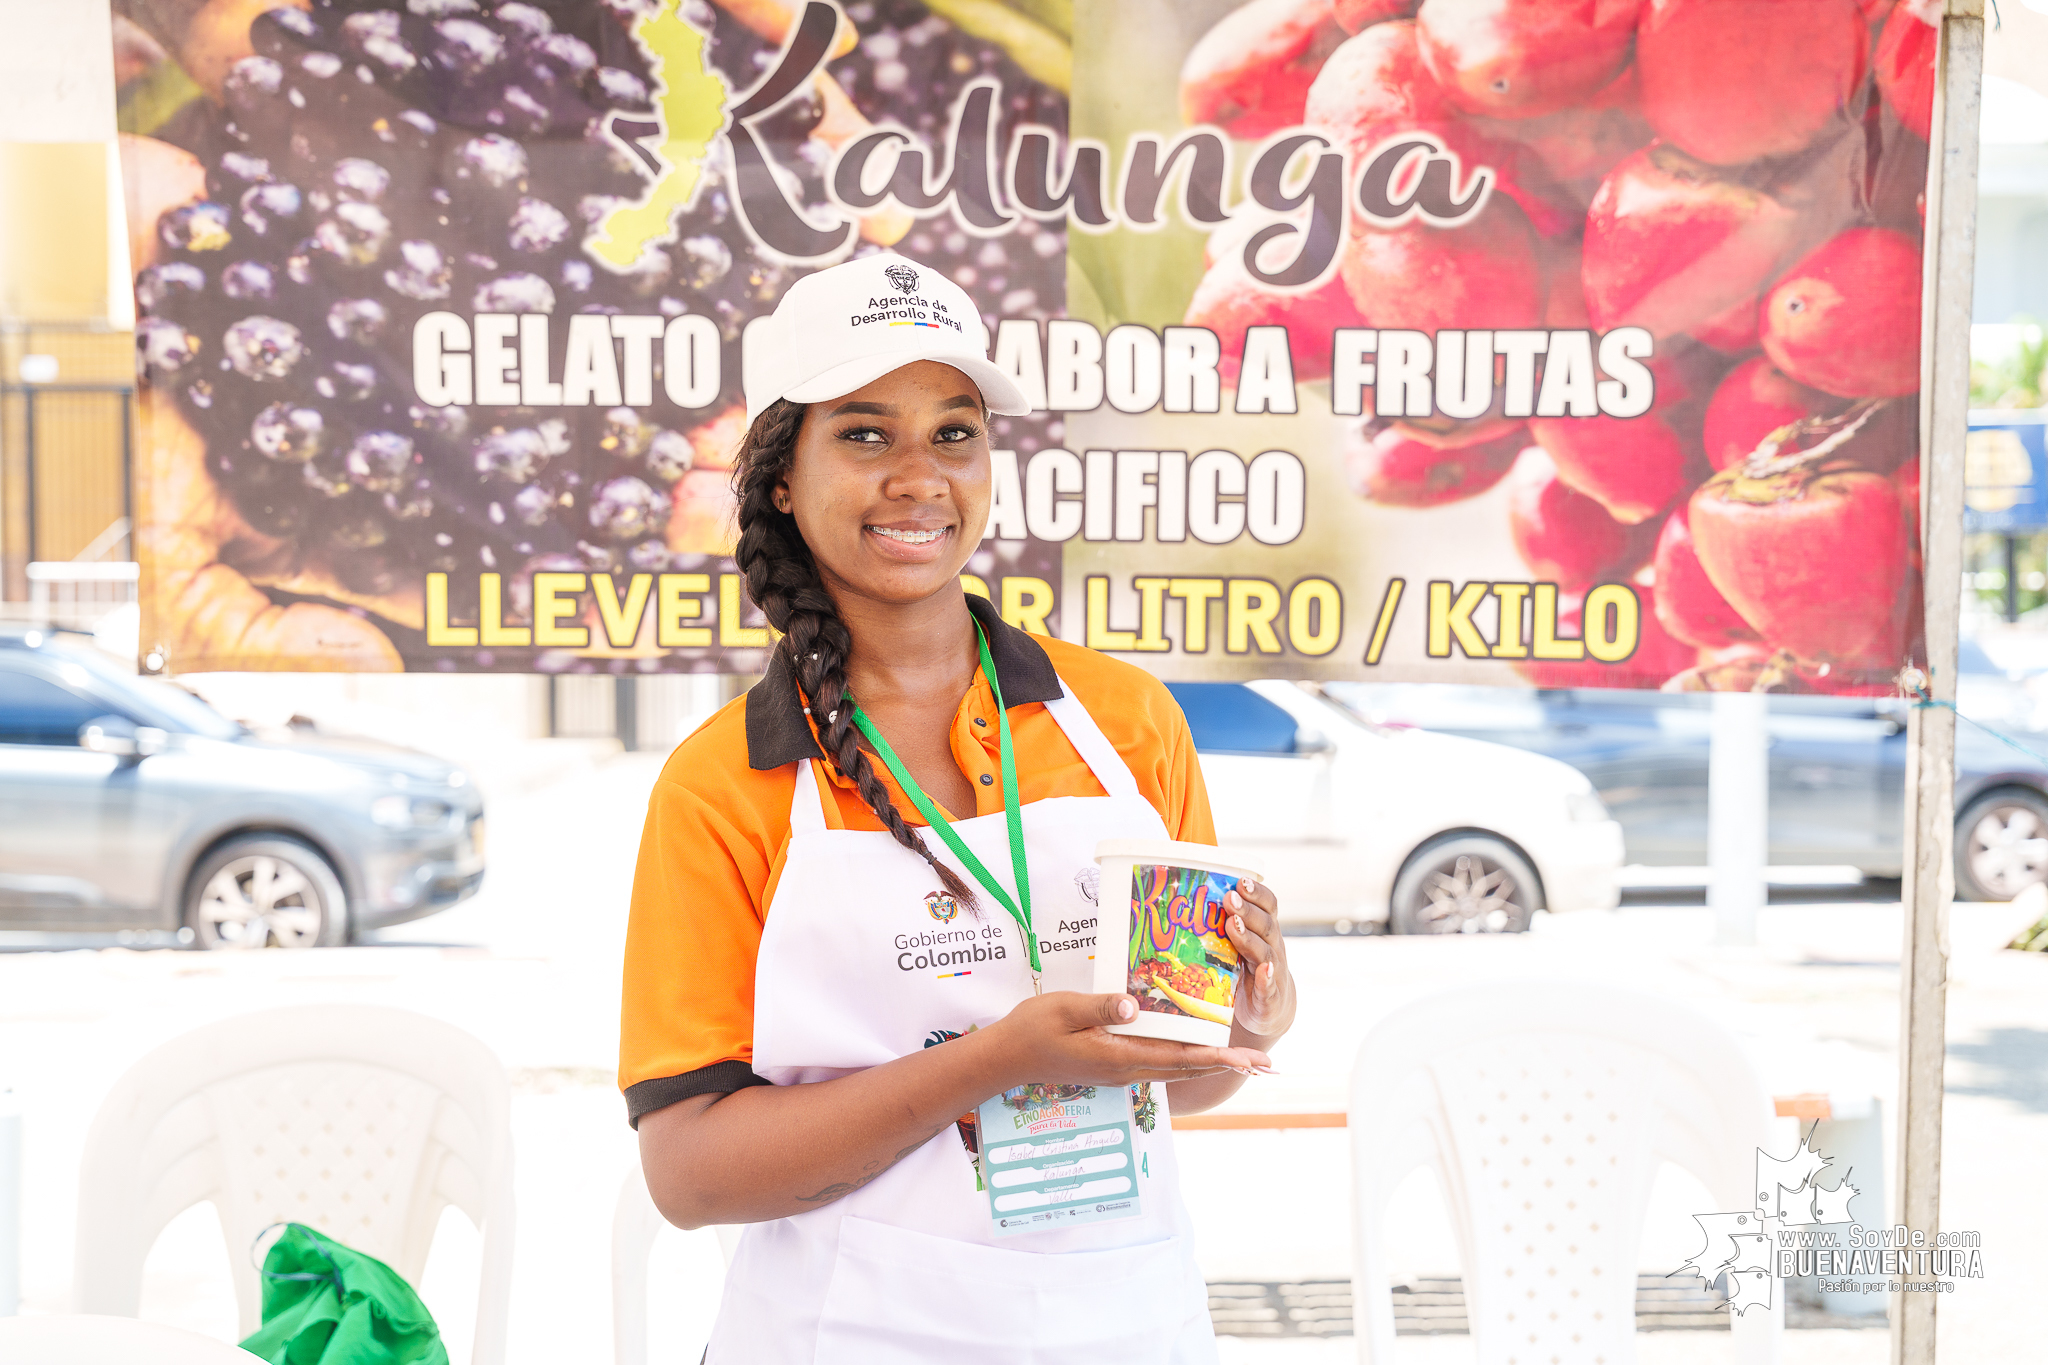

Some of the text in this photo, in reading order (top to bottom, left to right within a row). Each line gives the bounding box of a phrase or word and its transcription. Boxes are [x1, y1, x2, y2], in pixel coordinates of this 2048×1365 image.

[606, 0, 1492, 289] Kalunga
[868, 295, 948, 313] Agencia de
[851, 308, 963, 333] Desarrollo Rural
[411, 309, 723, 410] GELATO
[984, 318, 1222, 415] ABOR
[1234, 324, 1299, 415] A
[1331, 326, 1655, 420] FRUTAS
[982, 448, 1306, 546] ACIFICO
[424, 571, 787, 649] LLEVEL
[1084, 575, 1344, 658] LITRO
[1425, 580, 1640, 664] KILO
[1129, 864, 1227, 952] Kalu
[894, 924, 1003, 950] Gobierno de
[1058, 917, 1098, 934] Agen
[897, 941, 1007, 971] Colombia
[1039, 936, 1097, 954] Desarr
[1013, 1104, 1092, 1130] ETNOAGROFERIA
[1028, 1119, 1077, 1134] para la Vida
